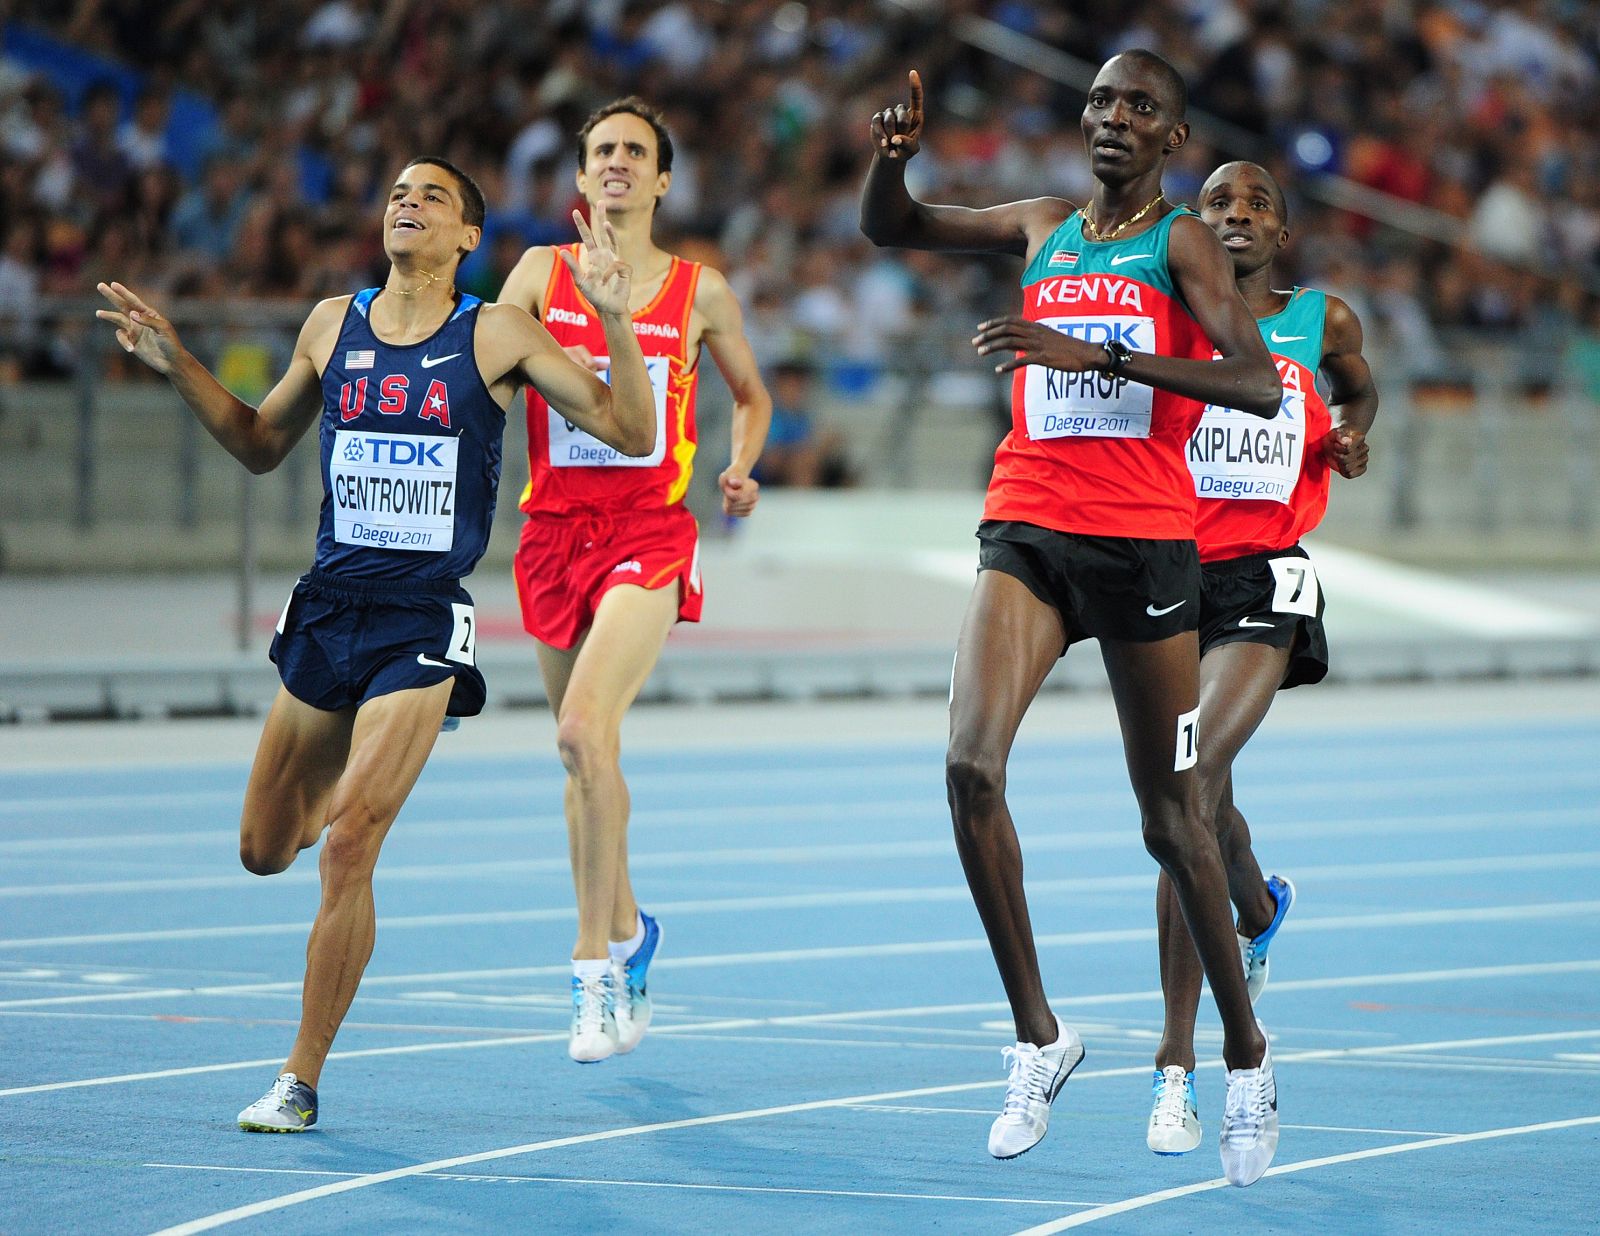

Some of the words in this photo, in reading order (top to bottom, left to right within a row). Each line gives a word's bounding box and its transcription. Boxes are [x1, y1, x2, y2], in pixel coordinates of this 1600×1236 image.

[1036, 277, 1143, 312] KENYA
[632, 321, 680, 339] ESPAÑA
[1057, 323, 1142, 349] TDK
[1046, 365, 1129, 400] KIPROP
[339, 374, 451, 429] USA
[1044, 415, 1097, 434] Daegu
[1097, 417, 1130, 432] 2011
[365, 438, 444, 467] TDK
[569, 445, 618, 464] Daegu
[1189, 427, 1297, 467] KIPLAGAT
[335, 474, 453, 516] CENTROWITZ
[1200, 476, 1254, 497] Daegu
[1255, 481, 1285, 496] 2011
[351, 523, 400, 547] Daegu
[401, 531, 433, 546] 2011
[1286, 567, 1306, 603] 7
[459, 616, 472, 653] 2
[1183, 722, 1200, 758] 1
